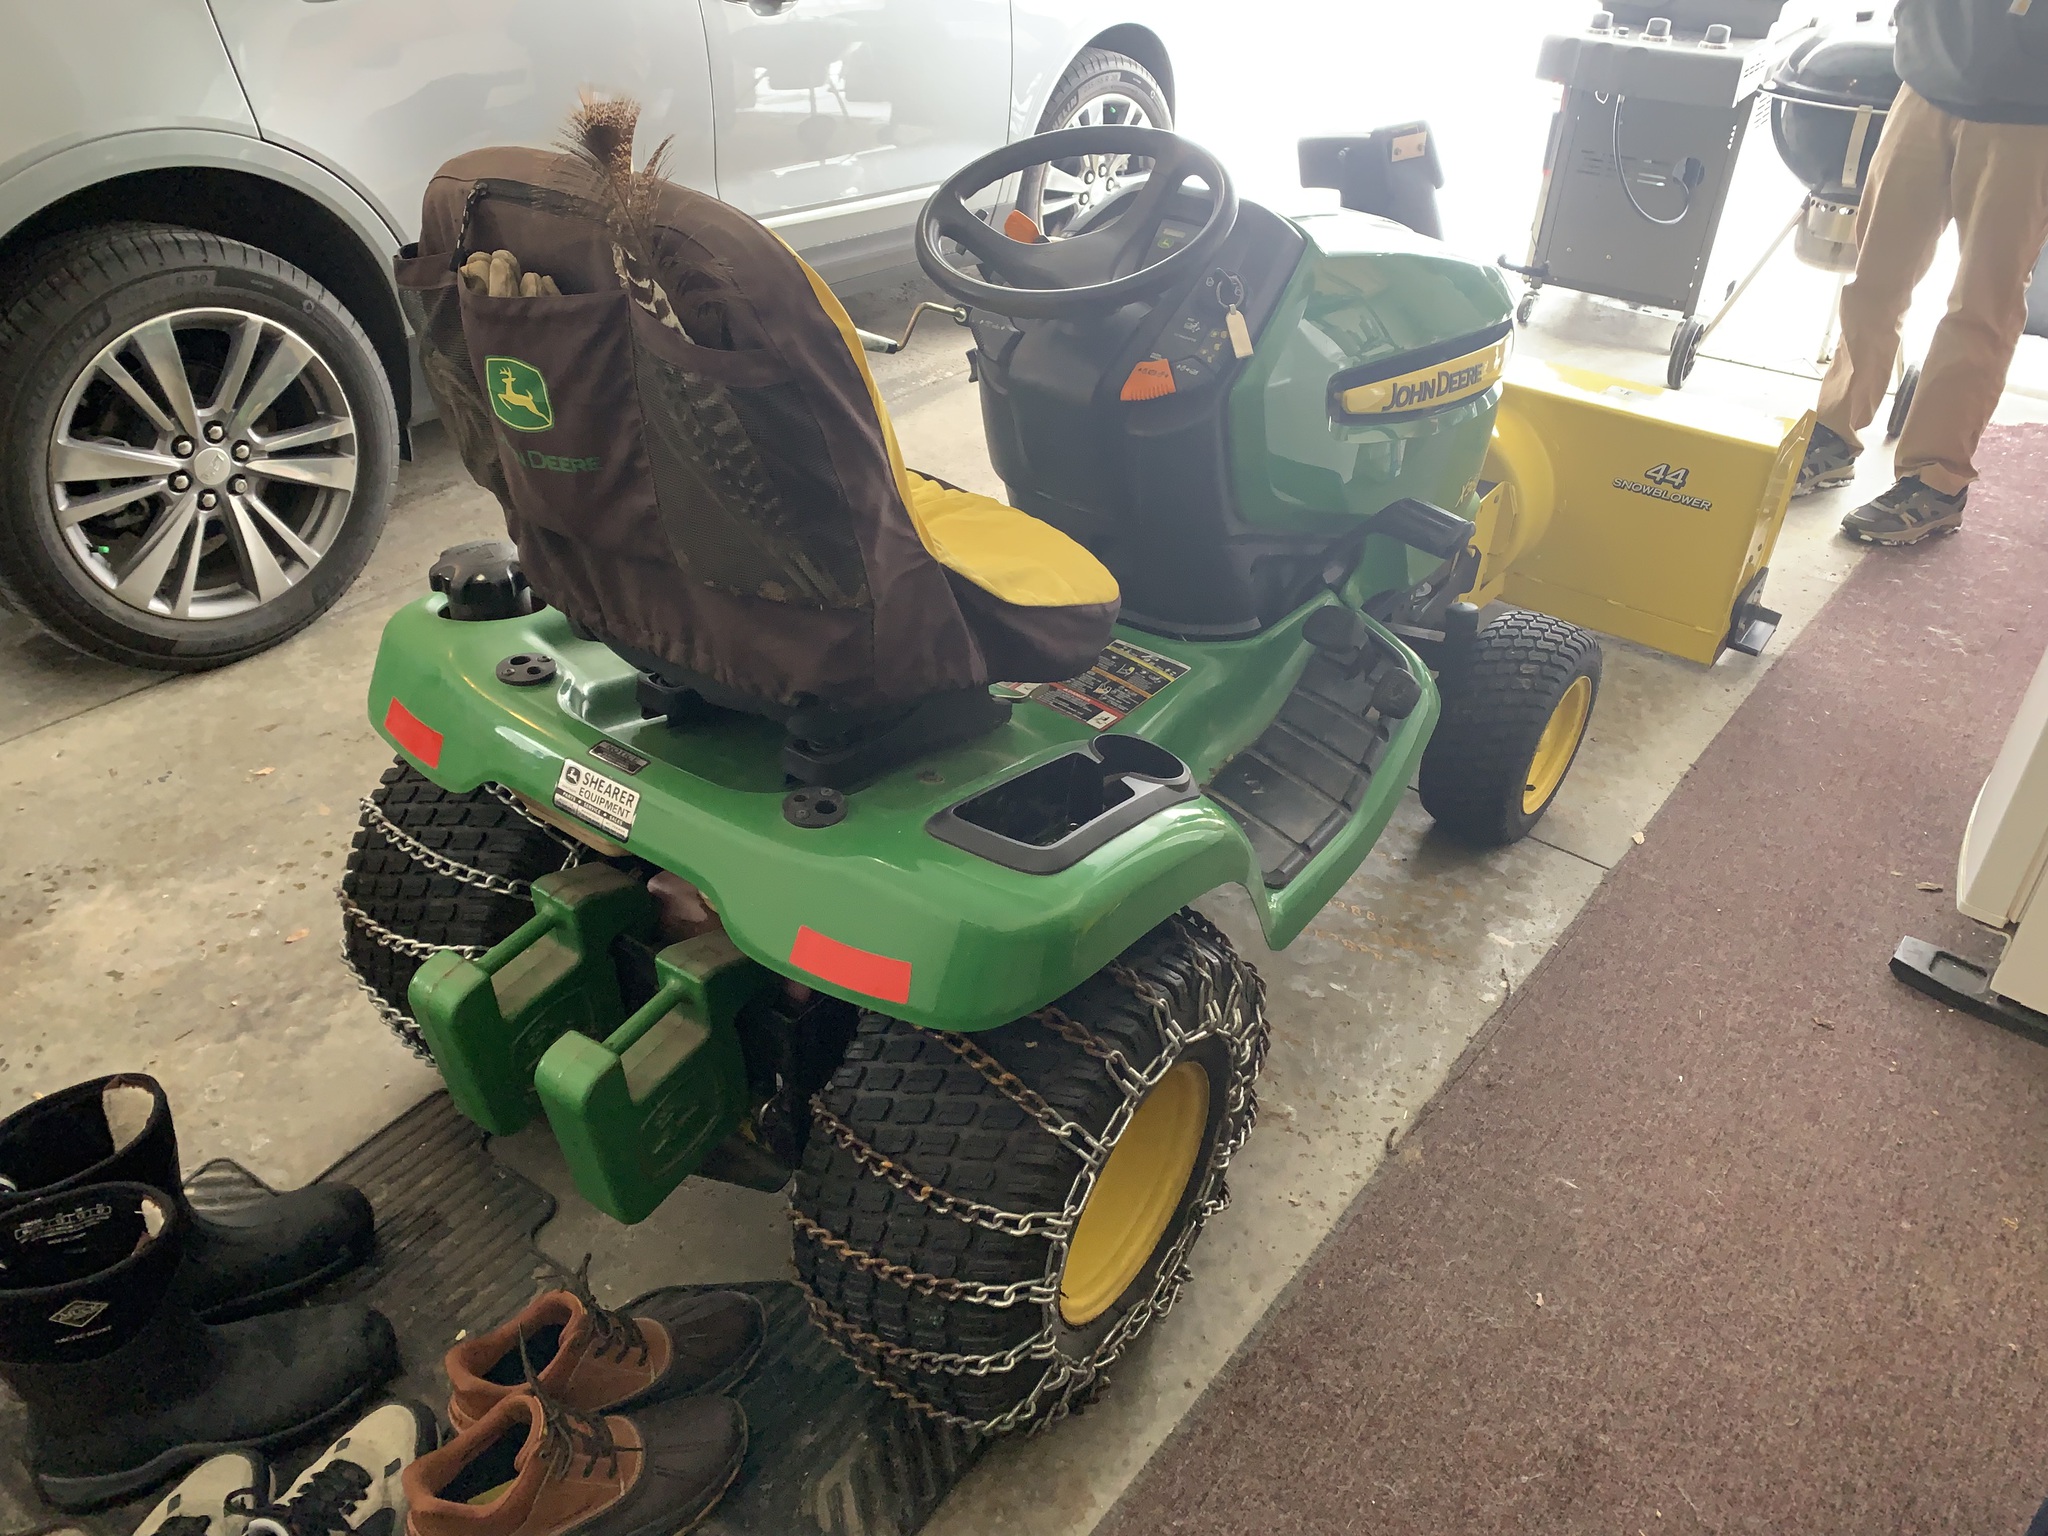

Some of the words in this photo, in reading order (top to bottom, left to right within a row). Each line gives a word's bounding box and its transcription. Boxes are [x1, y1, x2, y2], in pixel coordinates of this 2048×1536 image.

[1381, 379, 1436, 412] JOHN
[1436, 363, 1483, 398] DEERE
[527, 450, 602, 473] DEERE
[1644, 463, 1690, 490] 44
[1612, 477, 1713, 511] SNOWBLOWER
[562, 791, 577, 802] PARTS
[583, 802, 601, 814] SERVICE
[578, 788, 631, 819] EQUIPMENT
[582, 772, 635, 808] SHEARER
